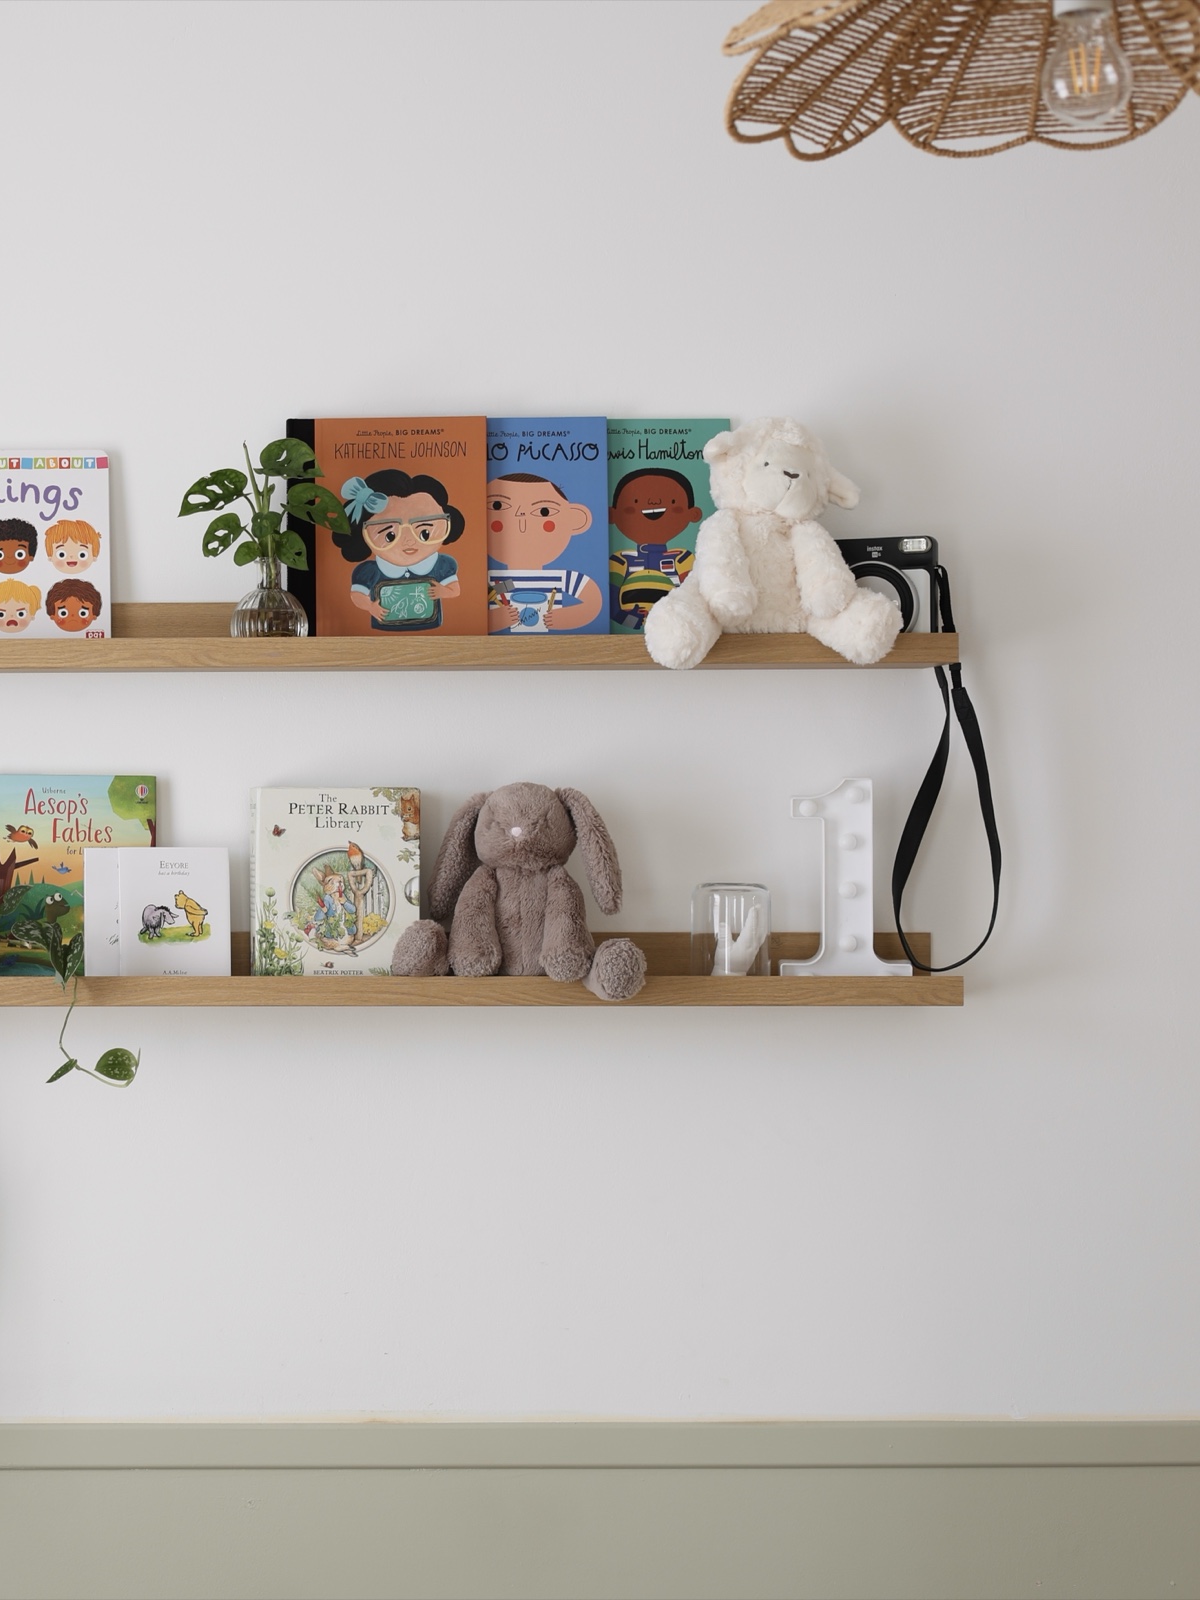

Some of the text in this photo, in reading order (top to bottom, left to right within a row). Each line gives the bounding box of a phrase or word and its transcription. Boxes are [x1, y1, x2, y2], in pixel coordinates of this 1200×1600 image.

[334, 441, 467, 459] KATHERINE JOHNSON
[638, 438, 704, 461] Hamilton
[35, 457, 94, 469] ABOUT
[319, 793, 337, 803] The
[24, 788, 89, 823] Aesop's
[289, 802, 390, 815] PETER RABBIT
[52, 817, 113, 843] Fables
[315, 816, 363, 832] Library
[66, 846, 77, 855] for
[159, 860, 189, 869] EEYORE
